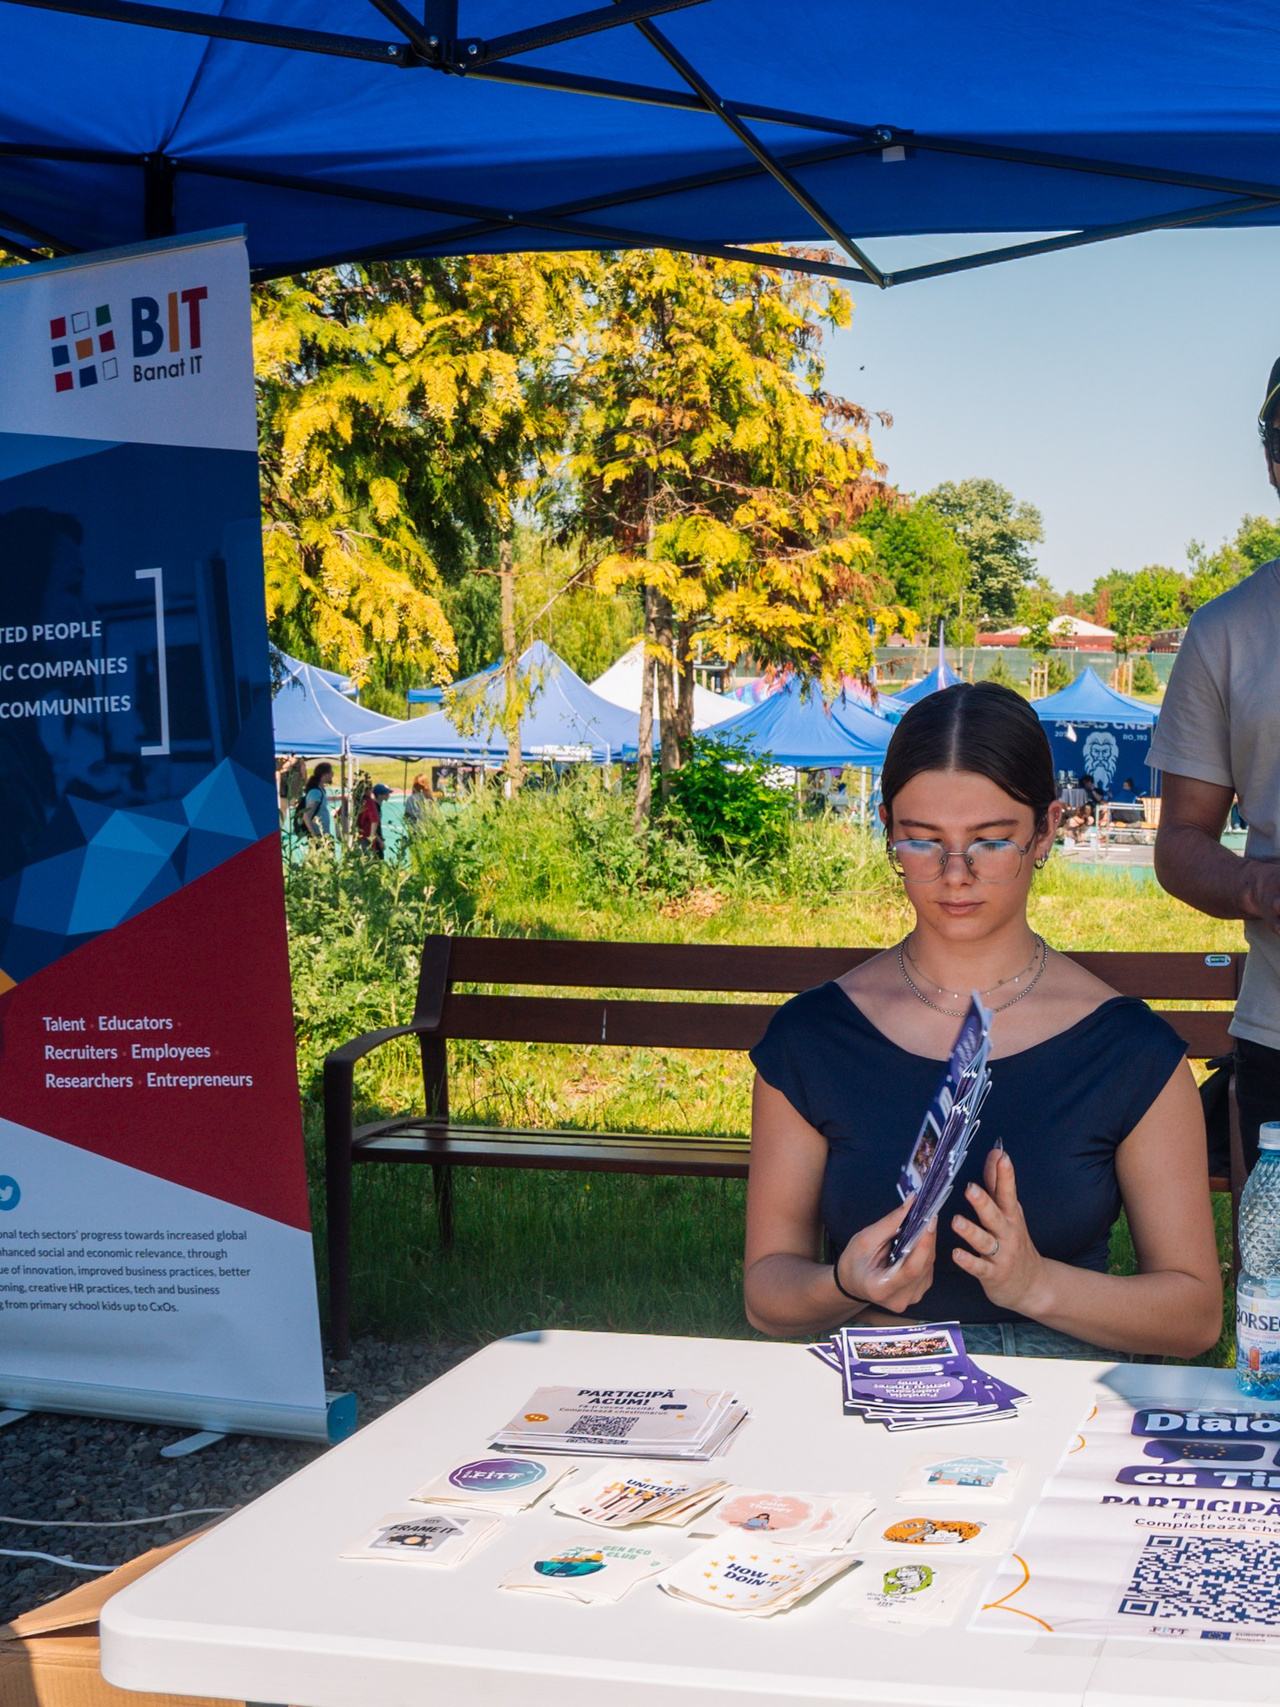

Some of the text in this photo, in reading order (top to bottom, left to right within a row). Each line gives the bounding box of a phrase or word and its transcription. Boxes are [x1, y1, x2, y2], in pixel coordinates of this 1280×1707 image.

[131, 286, 208, 358] BIT
[133, 356, 203, 383] Banat IT
[32, 621, 102, 641] PEOPLE
[18, 657, 128, 680] COMPANIES
[0, 695, 131, 719] COMMUNITIES
[43, 1015, 173, 1032] Talent Educators
[44, 1043, 211, 1061] Recruiters Employees
[45, 1072, 253, 1090] Researchers Entrepreneurs
[19, 1230, 40, 1240] tech
[80, 1231, 123, 1242] progress
[124, 1230, 165, 1240] towards
[166, 1230, 215, 1241] increased
[216, 1230, 248, 1242] global
[38, 1248, 65, 1258] social
[67, 1248, 85, 1258] and
[86, 1248, 134, 1258] economic
[135, 1248, 186, 1259] relevance,
[187, 1248, 228, 1261] through
[11, 1265, 22, 1275] of
[23, 1265, 77, 1276] innovation,
[78, 1266, 124, 1277] improved
[125, 1266, 168, 1277] business
[169, 1267, 217, 1278] practices,
[218, 1267, 251, 1277] better
[28, 1283, 68, 1293] creative
[69, 1284, 85, 1293] HR
[86, 1284, 133, 1295] practices,
[134, 1285, 156, 1294] tech
[157, 1285, 176, 1295] and
[177, 1285, 221, 1295] business
[5, 1300, 29, 1310] from
[30, 1301, 68, 1312] primary
[69, 1301, 100, 1311] school
[101, 1302, 122, 1311] kids
[123, 1303, 136, 1313] up
[138, 1303, 148, 1312] to
[577, 1389, 676, 1398] PARTICIPĂ
[588, 1397, 650, 1406] ACUM!
[627, 1479, 673, 1493] UNITED
[1134, 1472, 1198, 1486] cu
[1135, 1518, 1247, 1532] Completează
[1217, 1516, 1266, 1525] vocea
[389, 1524, 439, 1533] FRAME
[605, 1551, 638, 1560] CLUB
[628, 1547, 652, 1556] ECO
[727, 1563, 769, 1579] HOW
